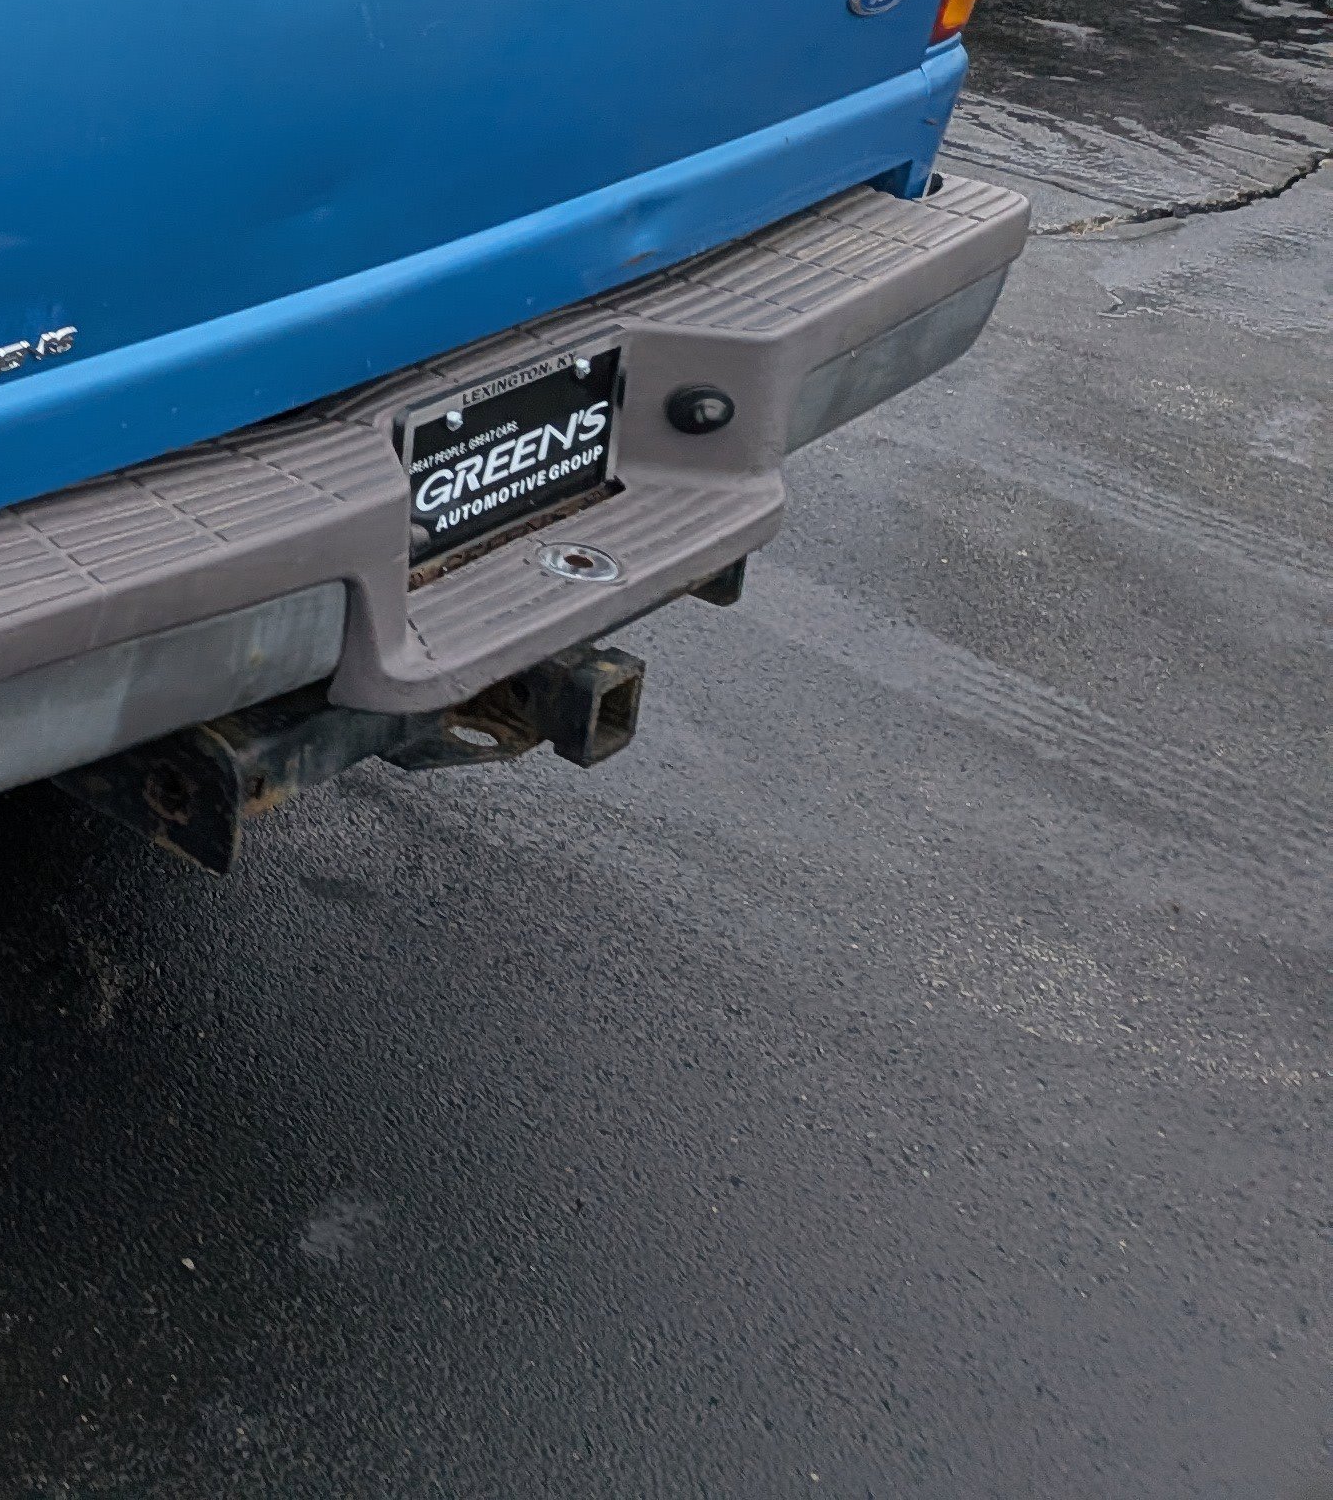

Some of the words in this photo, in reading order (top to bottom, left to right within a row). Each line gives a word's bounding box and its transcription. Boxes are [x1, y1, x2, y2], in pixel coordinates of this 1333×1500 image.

[416, 400, 608, 512] GREEN'S
[435, 470, 547, 533] AUTOMOTIVE
[548, 444, 604, 481] GROUP
